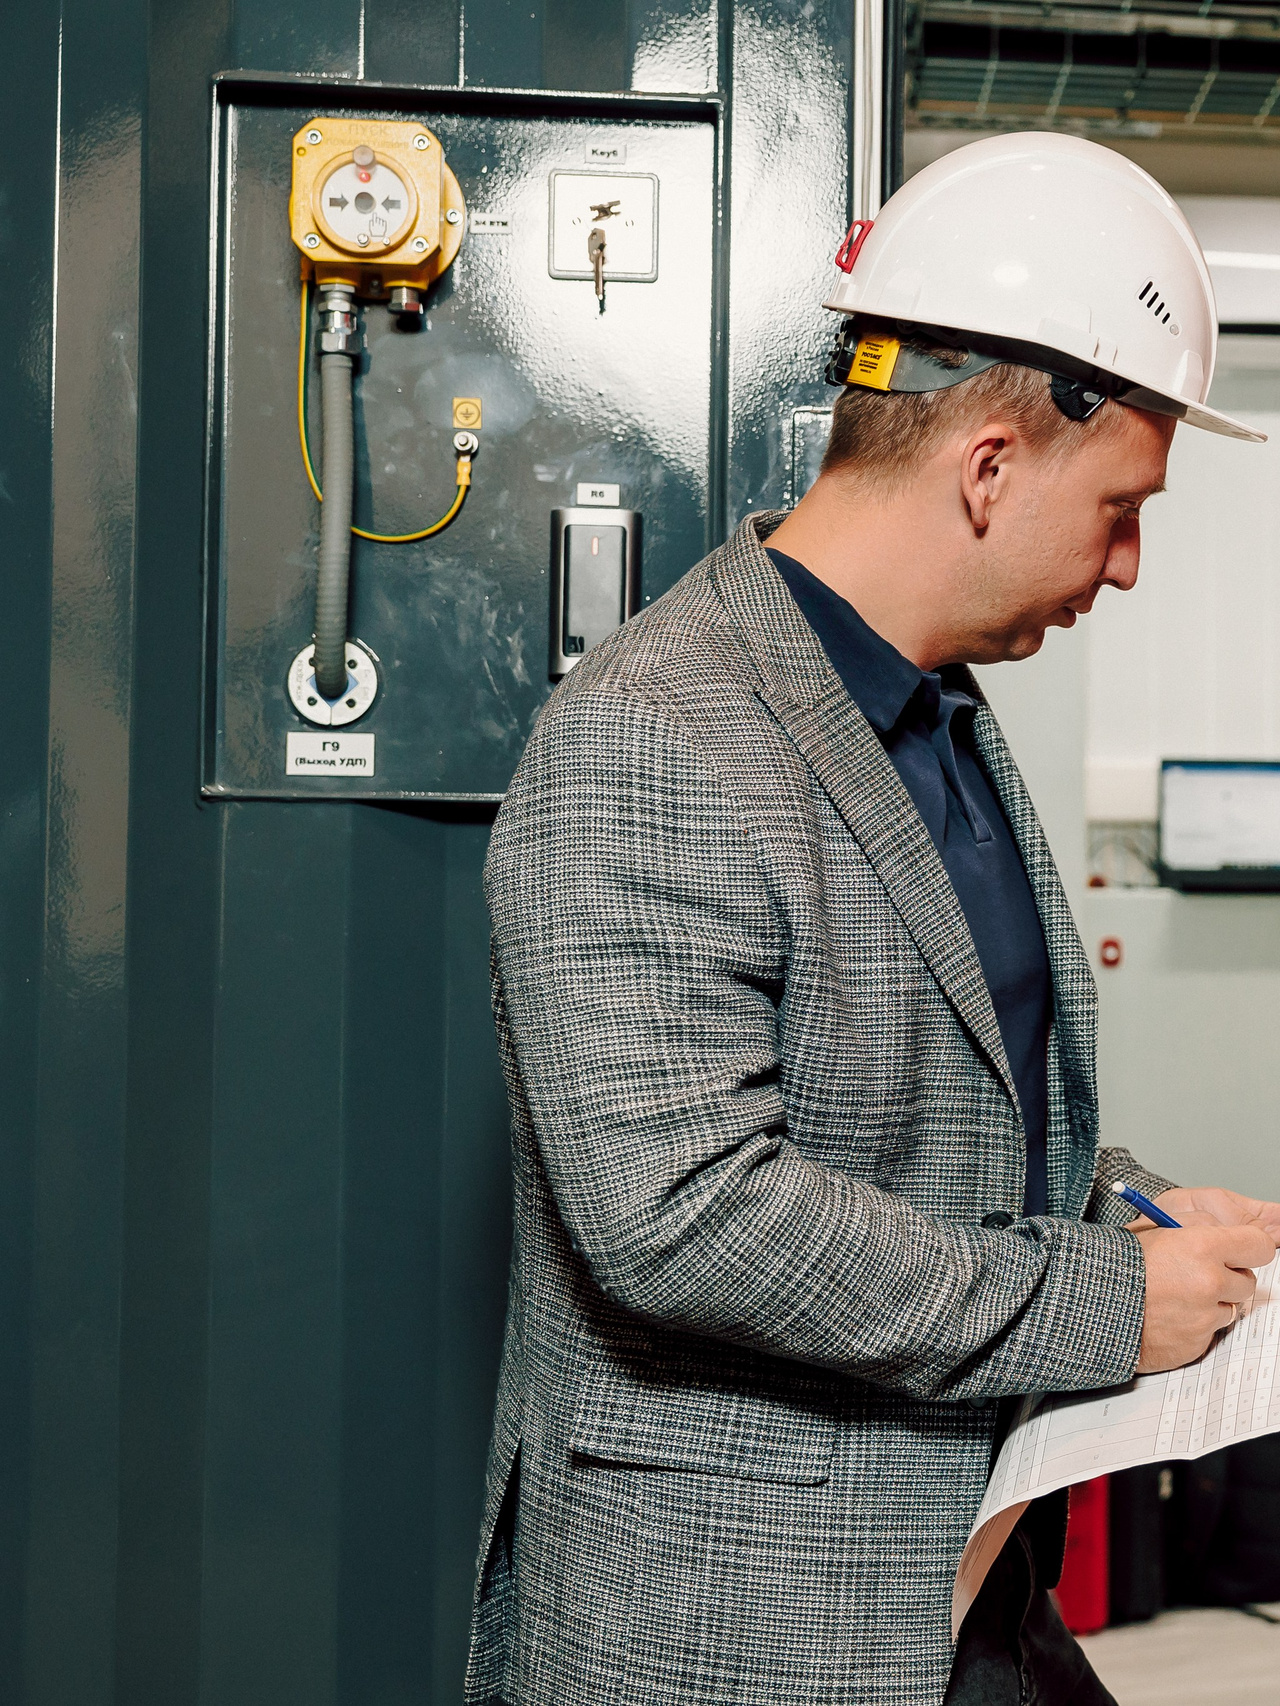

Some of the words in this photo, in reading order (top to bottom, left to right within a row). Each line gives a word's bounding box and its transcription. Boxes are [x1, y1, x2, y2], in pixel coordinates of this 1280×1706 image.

[348, 123, 392, 137] ПУСК
[322, 741, 340, 752] Г9
[295, 757, 336, 767] (Выход
[339, 758, 367, 768] УДП)
